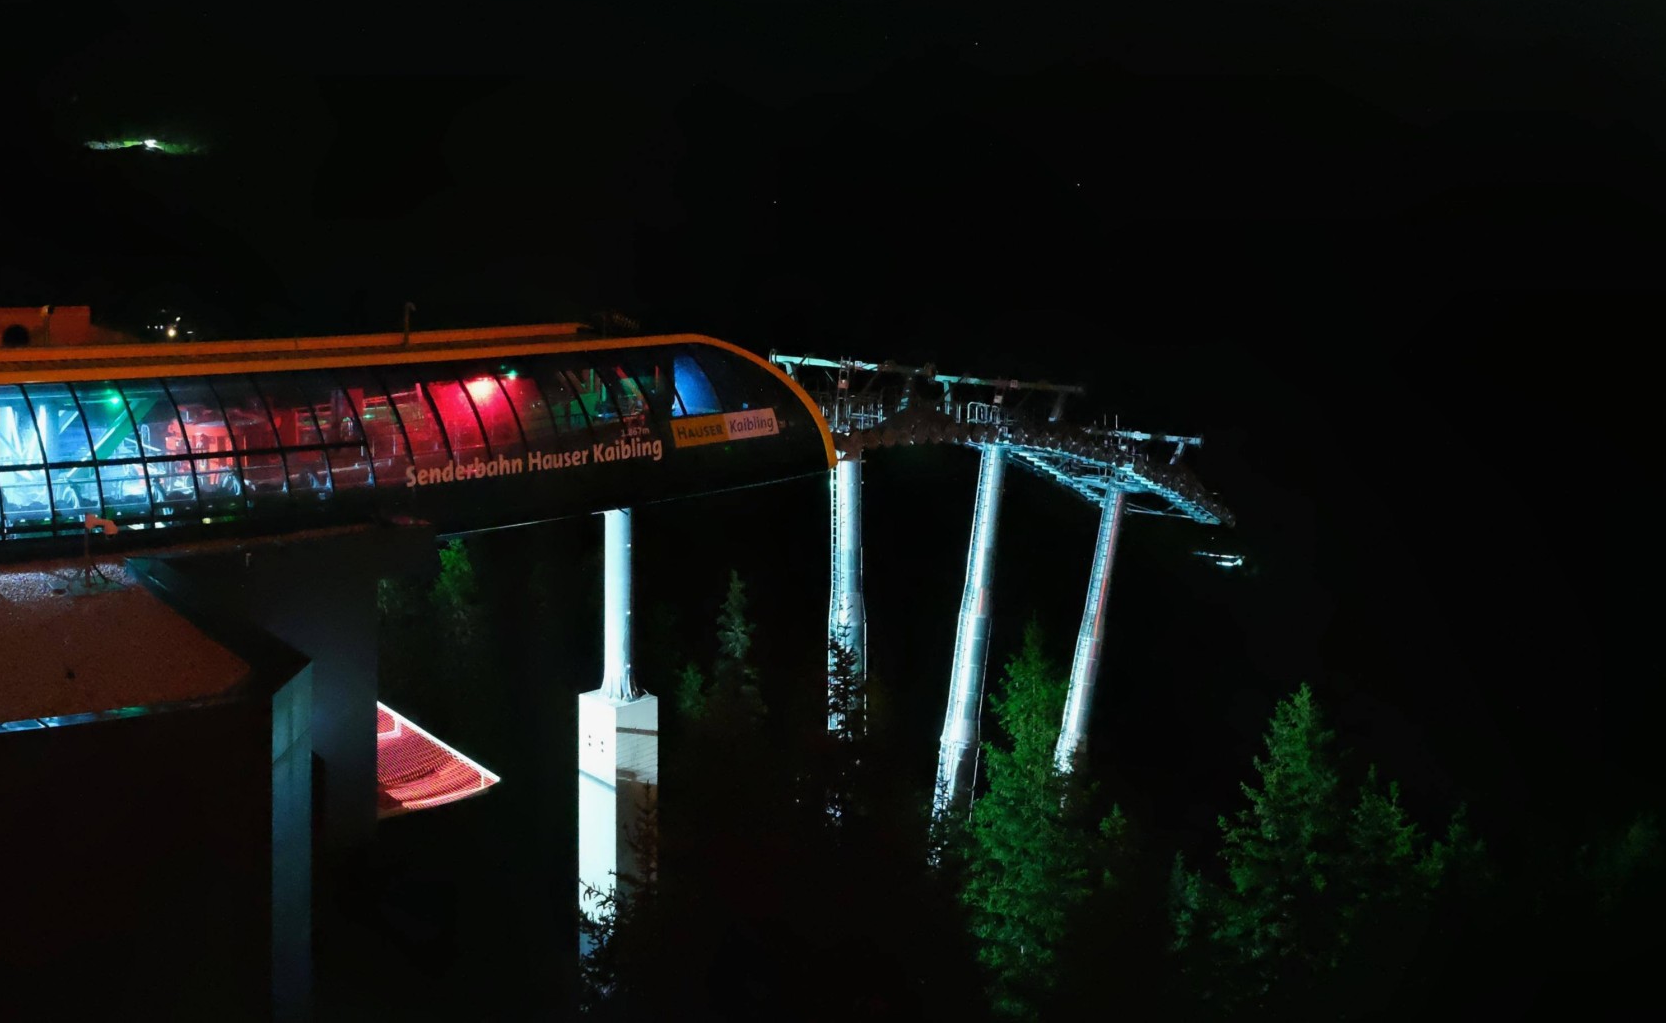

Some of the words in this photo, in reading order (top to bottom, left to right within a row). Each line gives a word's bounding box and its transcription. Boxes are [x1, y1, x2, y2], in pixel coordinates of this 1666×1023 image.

[677, 424, 724, 439] HAUSER
[730, 417, 774, 433] Kaibling
[406, 454, 522, 488] Senderbahn
[528, 449, 588, 473] Hauser
[593, 437, 663, 462] Kaibling
